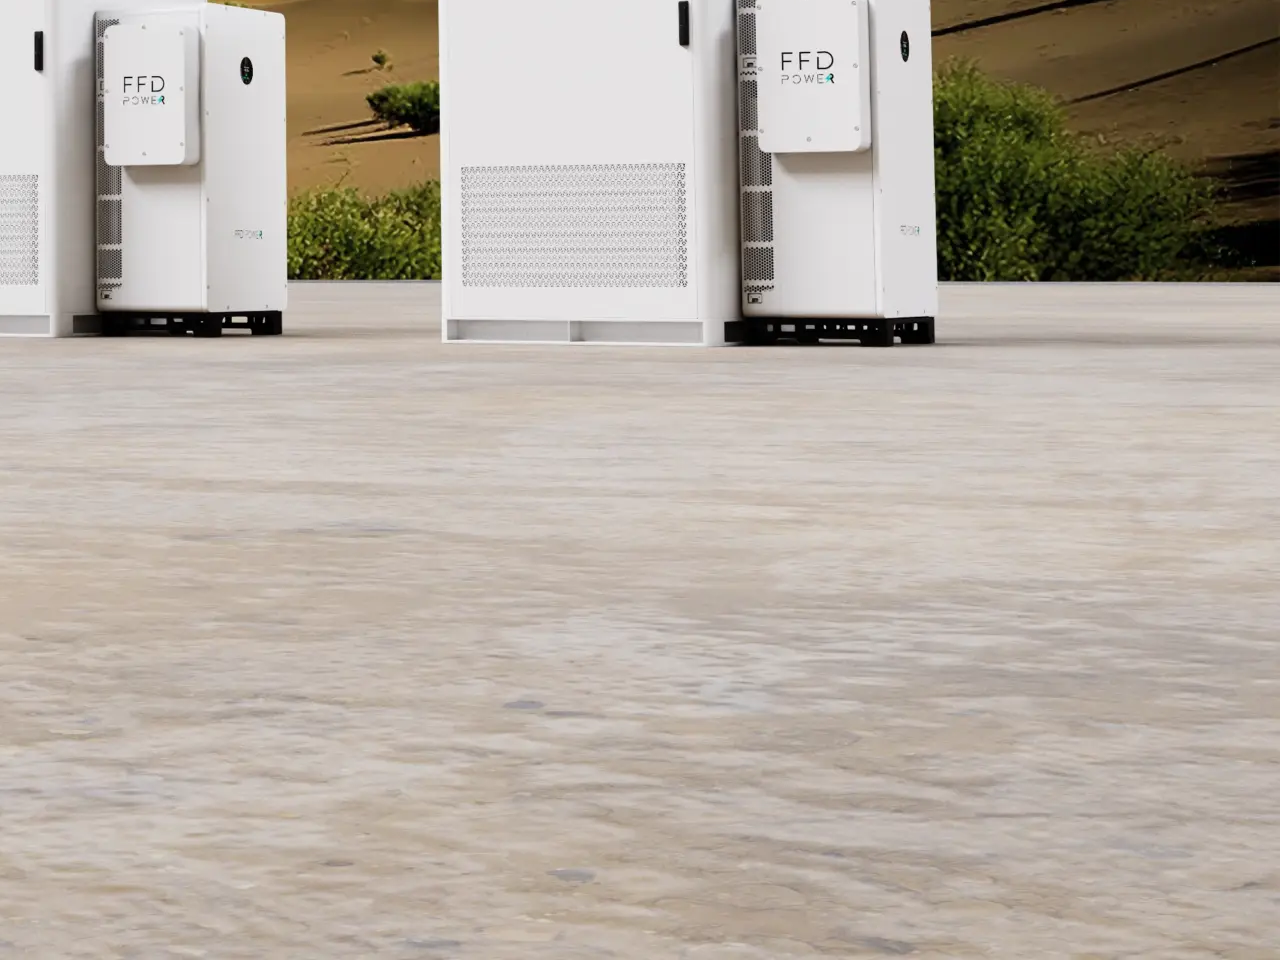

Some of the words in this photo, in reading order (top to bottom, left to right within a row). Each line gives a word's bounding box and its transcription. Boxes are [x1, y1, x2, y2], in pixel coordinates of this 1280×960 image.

[780, 50, 834, 71] FFD
[123, 75, 165, 93] FFD
[780, 73, 835, 85] POWER
[123, 95, 166, 106] POWER
